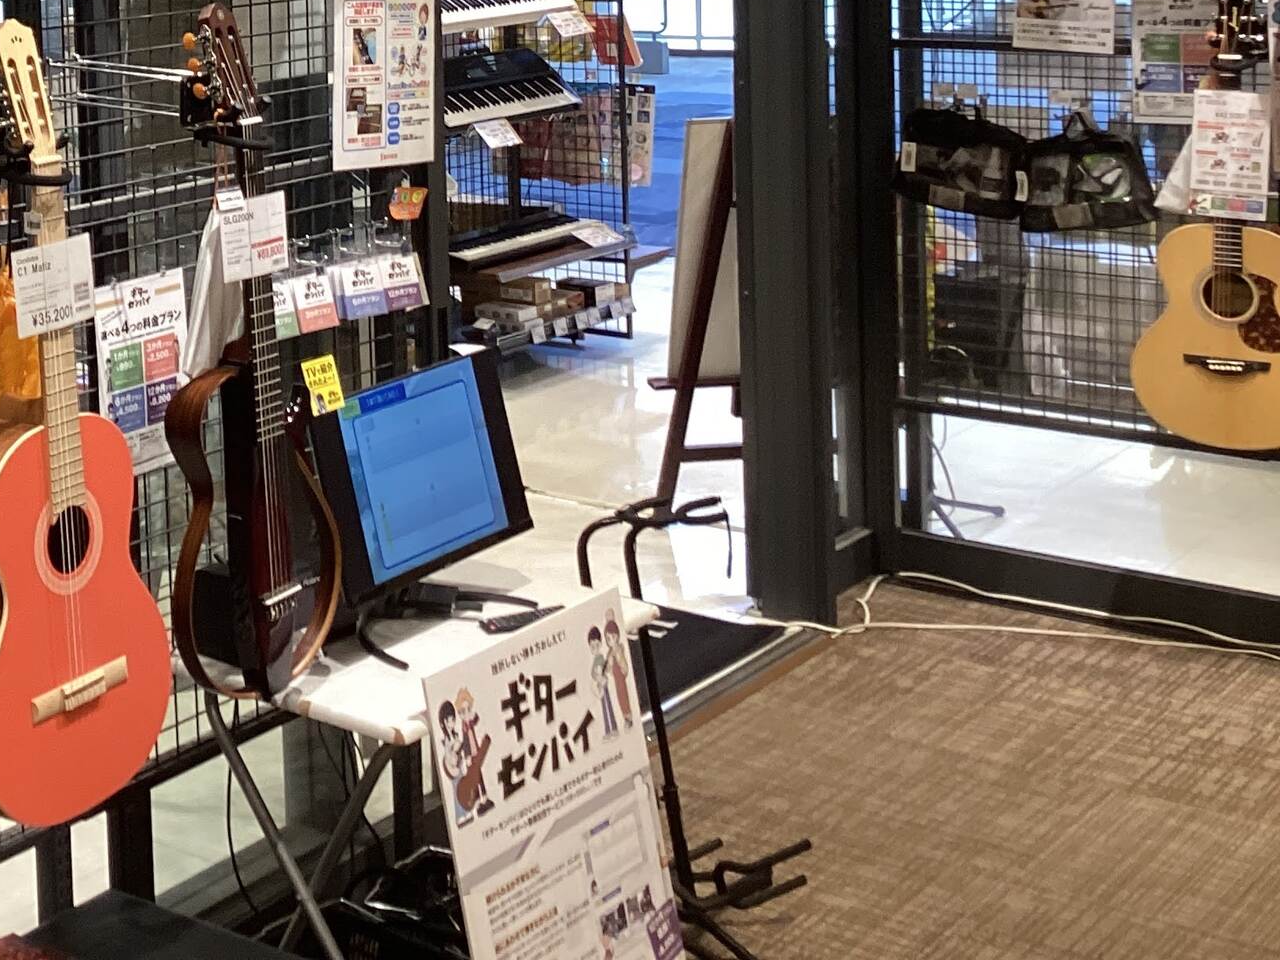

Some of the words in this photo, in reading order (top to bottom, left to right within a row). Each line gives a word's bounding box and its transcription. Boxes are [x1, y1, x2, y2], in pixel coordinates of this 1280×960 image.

[501, 672, 577, 742] ギター
[497, 709, 595, 800] センパイ
